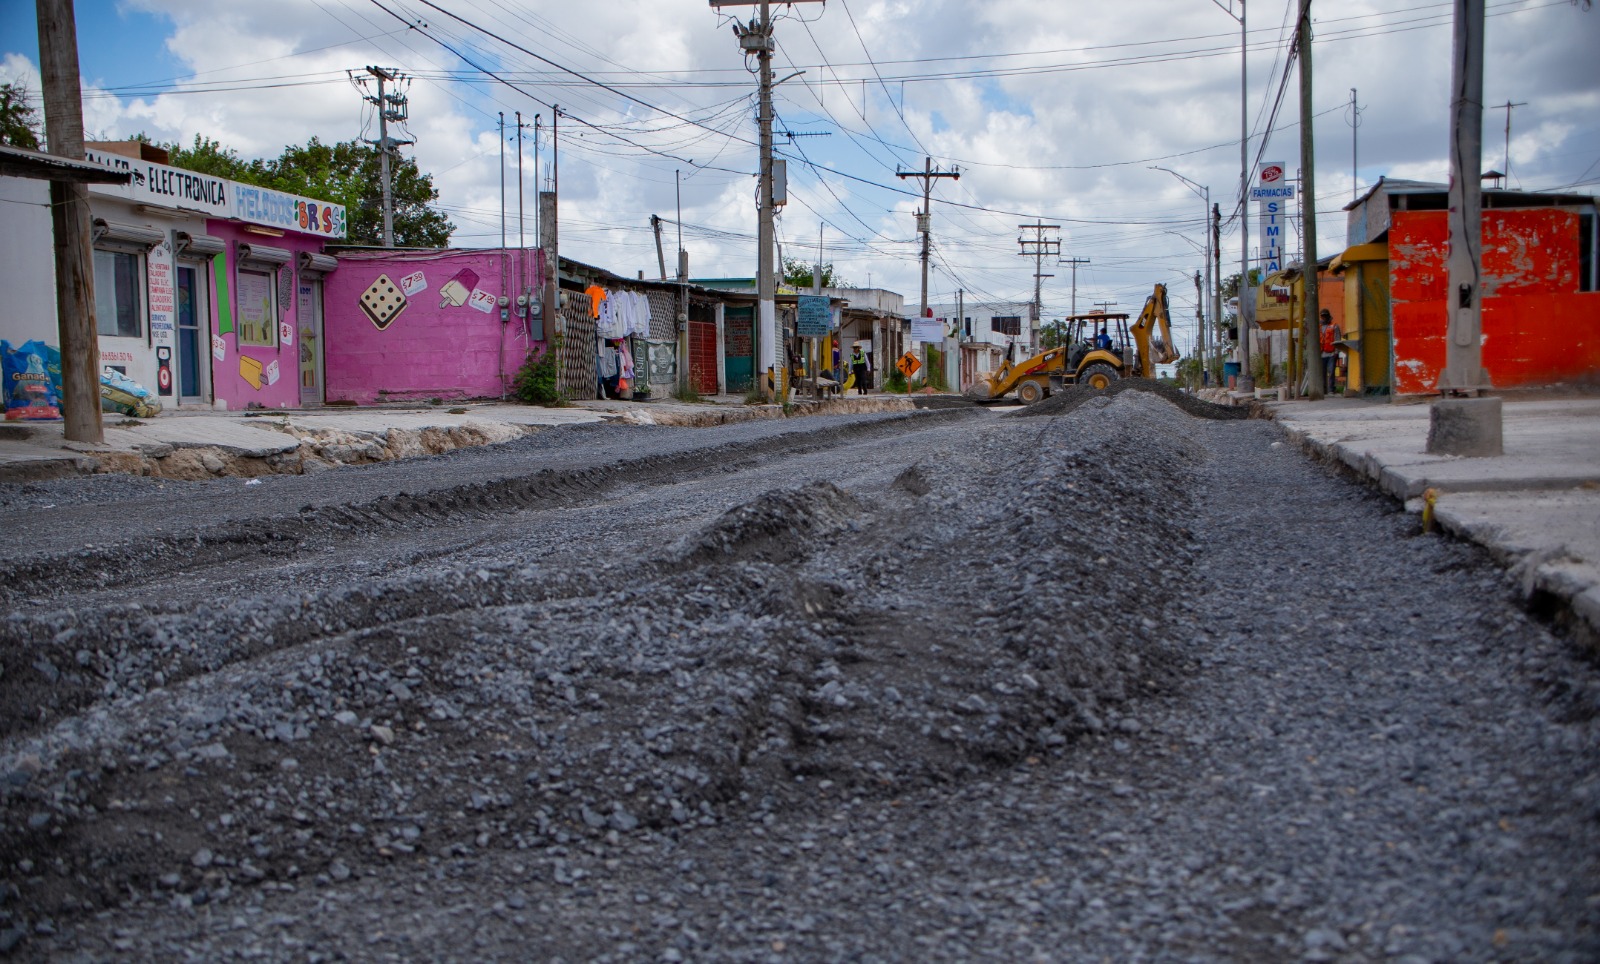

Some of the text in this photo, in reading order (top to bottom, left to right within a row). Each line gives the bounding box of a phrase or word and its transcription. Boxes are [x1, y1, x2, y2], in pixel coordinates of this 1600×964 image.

[148, 166, 226, 206] ELECTRONICA
[1253, 187, 1292, 197] FARMACIAS
[235, 185, 341, 236] HELADOS BRISS
[402, 272, 424, 290] $7.50
